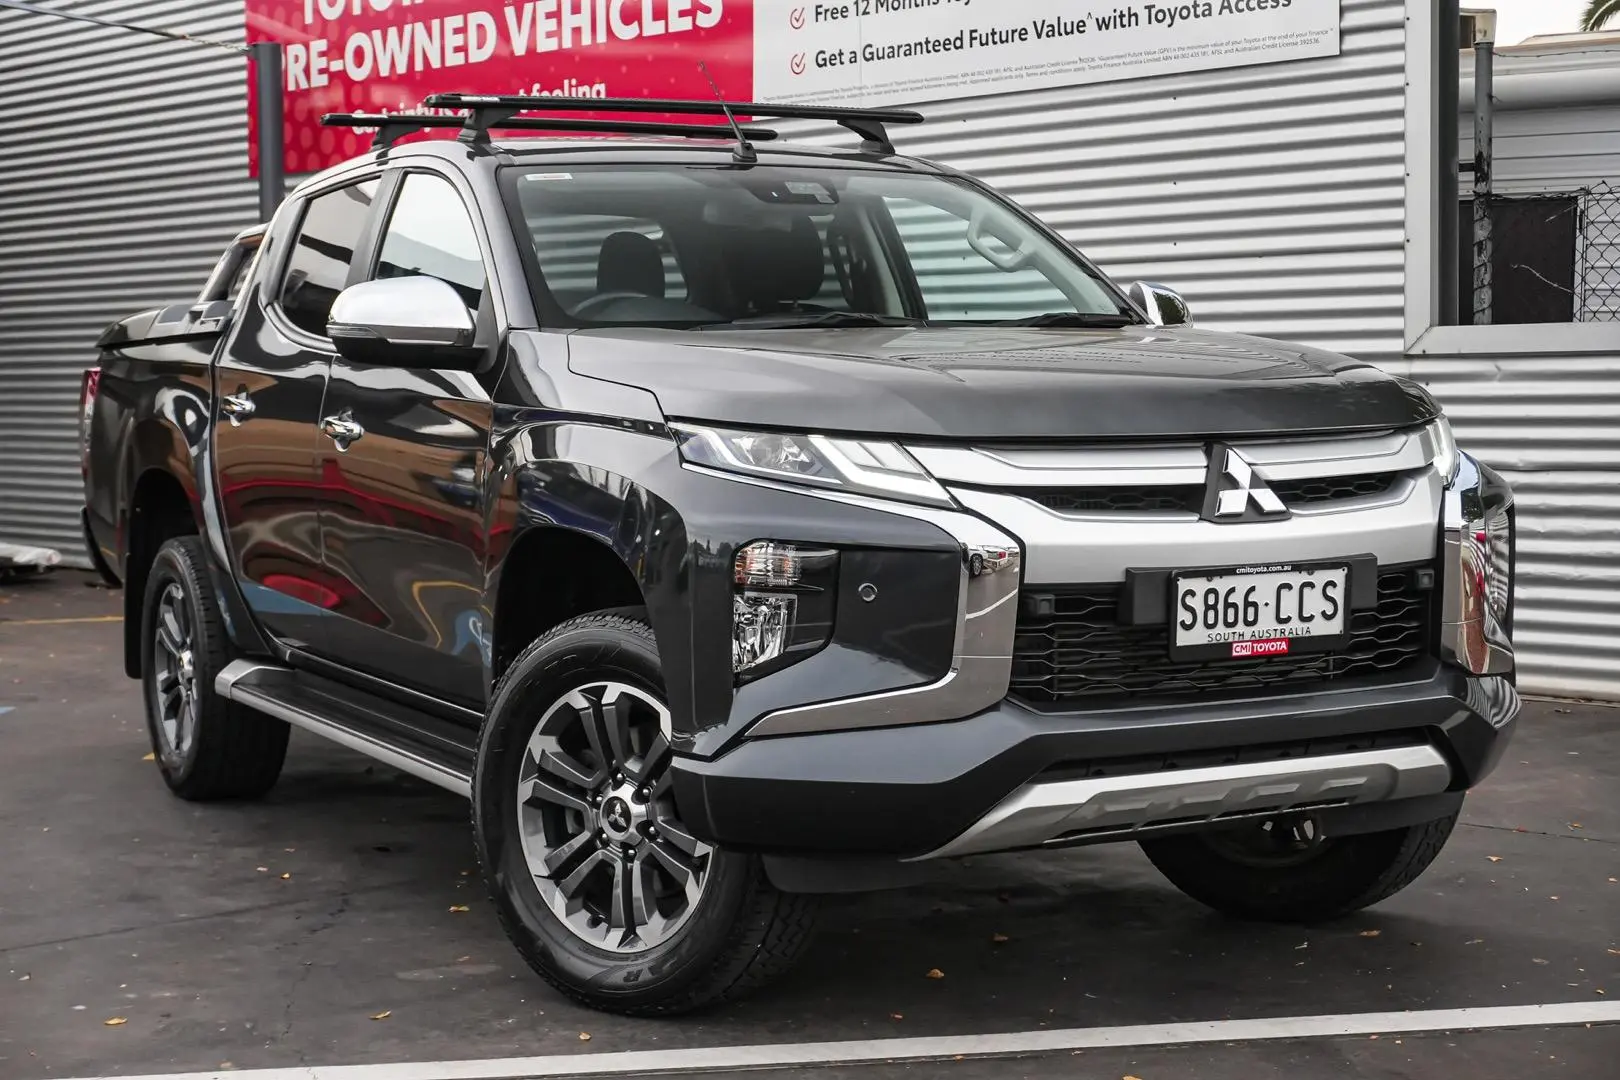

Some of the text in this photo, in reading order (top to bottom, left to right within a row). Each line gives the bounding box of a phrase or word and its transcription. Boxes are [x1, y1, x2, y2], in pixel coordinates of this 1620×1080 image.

[815, 5, 849, 22] Free
[853, 0, 870, 16] 12
[815, 49, 845, 68] Get
[849, 52, 857, 64] a
[862, 30, 964, 62] Guaranteed
[969, 26, 1028, 48] Future
[1096, 9, 1139, 31] with
[1144, 1, 1213, 28] Toyota
[1218, 0, 1292, 15] Access
[281, 0, 723, 91] RE-OWNED VEHICLES
[1236, 565, 1292, 575] cmitoyota.com.au
[1207, 626, 1312, 642] SOUTH AUSTRALIA
[1253, 641, 1288, 653] TOYOTA
